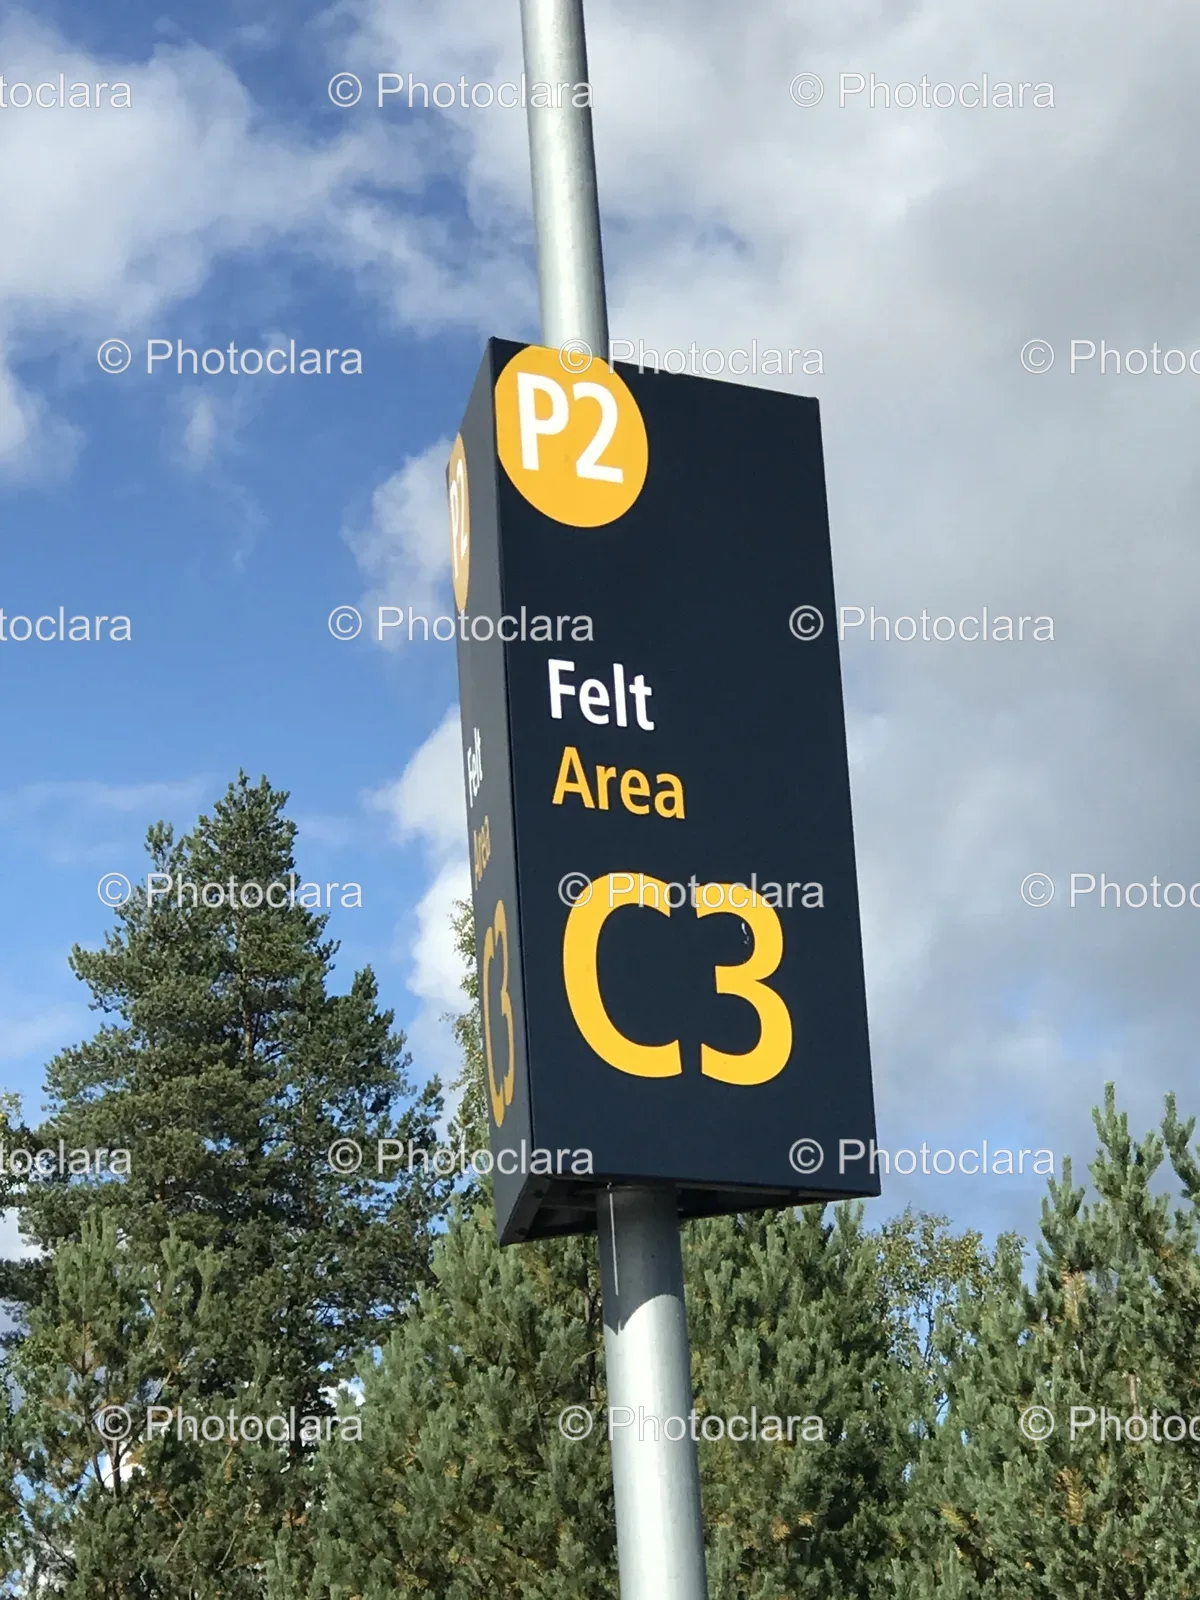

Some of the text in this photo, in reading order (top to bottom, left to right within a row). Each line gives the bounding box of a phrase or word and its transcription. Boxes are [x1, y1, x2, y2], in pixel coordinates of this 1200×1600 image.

[517, 372, 623, 484] P2
[450, 459, 468, 579] P2
[548, 659, 655, 731] Felt
[467, 727, 483, 808] Felt
[552, 746, 686, 819] Area
[473, 815, 491, 890] Area
[483, 900, 514, 1128] C3
[563, 872, 793, 1086] C3
